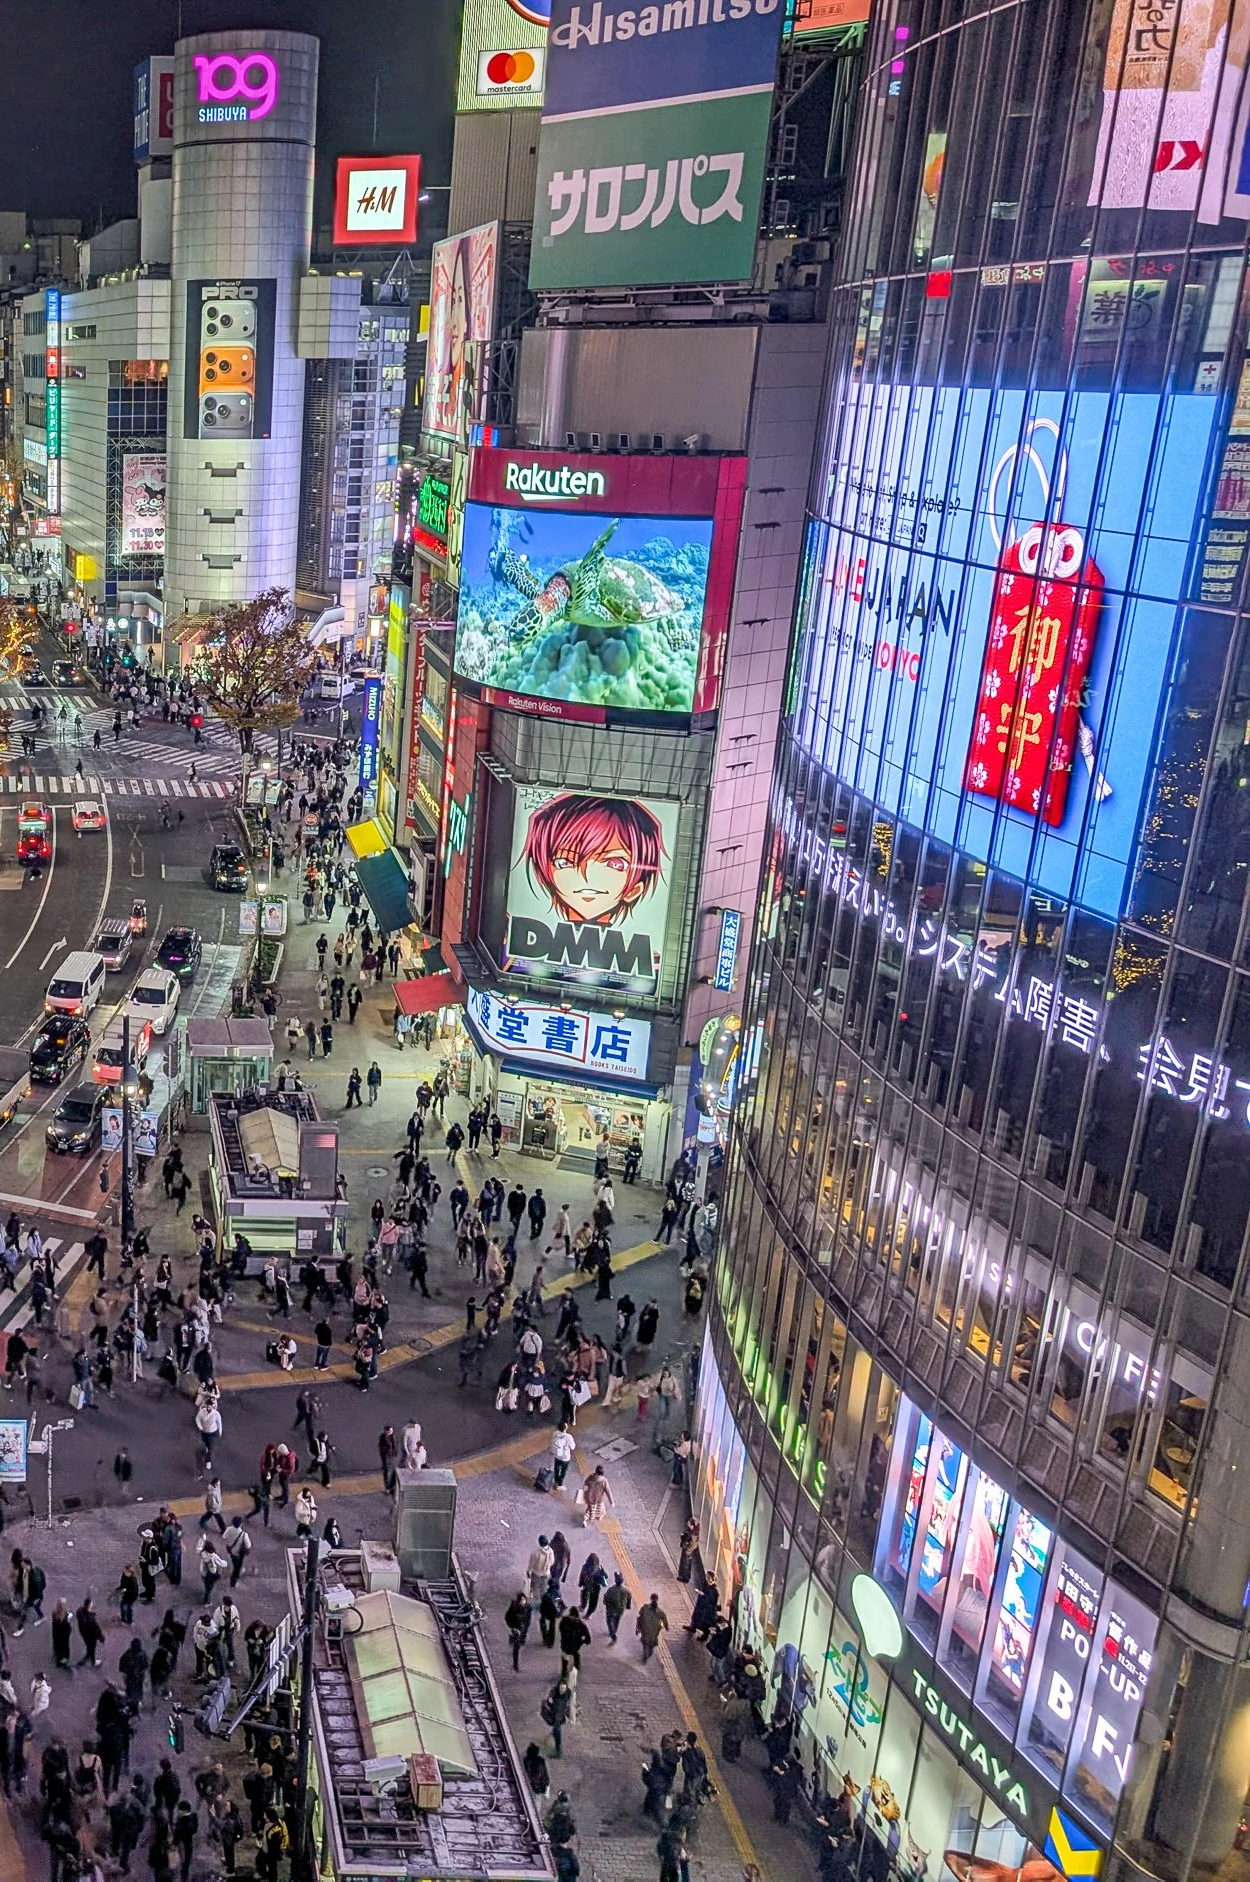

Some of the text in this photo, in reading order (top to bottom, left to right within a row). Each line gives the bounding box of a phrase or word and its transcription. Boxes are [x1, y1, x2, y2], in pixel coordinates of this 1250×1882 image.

[193, 53, 280, 121] 109
[486, 83, 532, 94] mastercard
[198, 106, 247, 123] SHIBUYA
[356, 184, 399, 215] H&M
[548, 152, 745, 236] サロンパス
[201, 285, 259, 301] PRO
[505, 462, 605, 498] Rakuten
[367, 686, 379, 721] MIZUHO
[508, 696, 562, 714] Rakuten Vision
[508, 915, 655, 980] DMM
[590, 1060, 638, 1075] BOOKS TAISEIDO
[912, 1668, 1029, 1818] TSUTAYA
